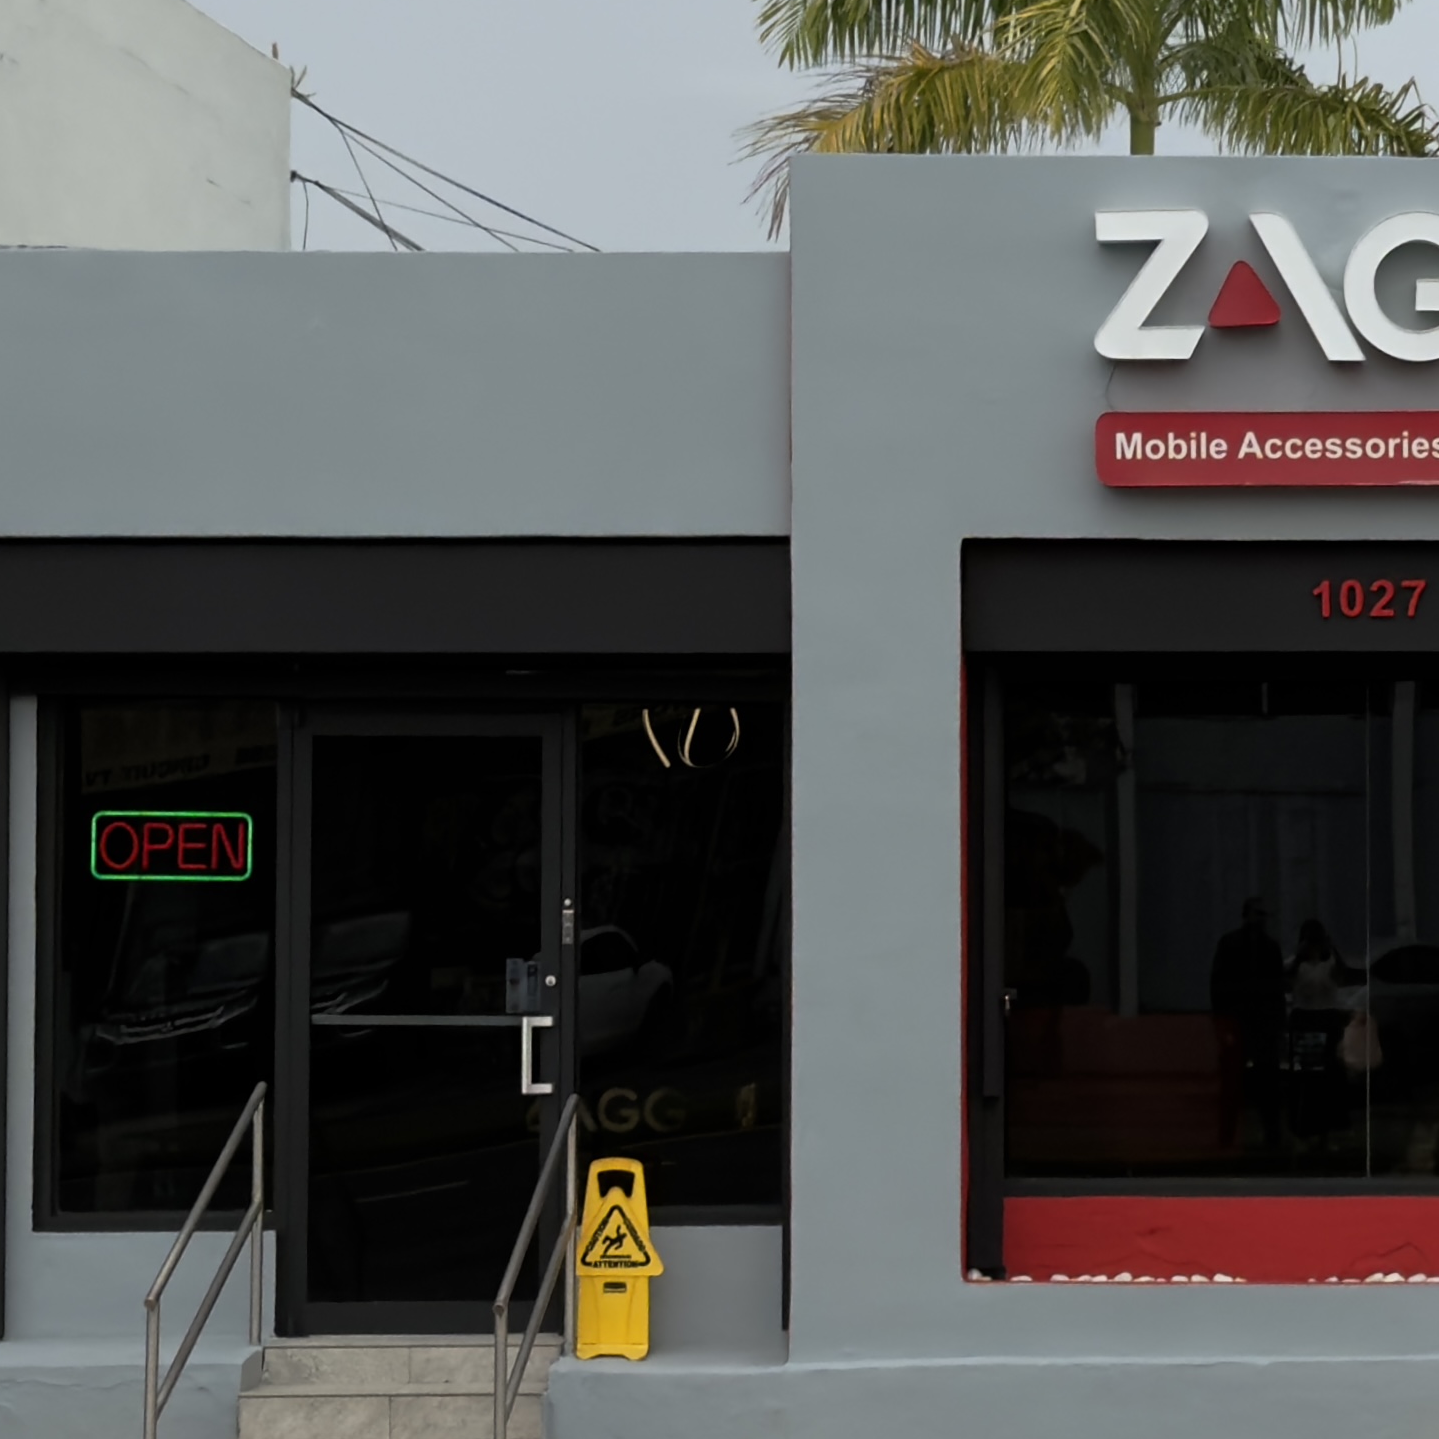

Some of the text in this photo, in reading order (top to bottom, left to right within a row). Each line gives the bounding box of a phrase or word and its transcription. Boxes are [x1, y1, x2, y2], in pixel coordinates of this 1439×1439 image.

[1114, 430, 1228, 461] Mobile
[1312, 579, 1428, 620] 1027
[99, 821, 245, 871] OPEN
